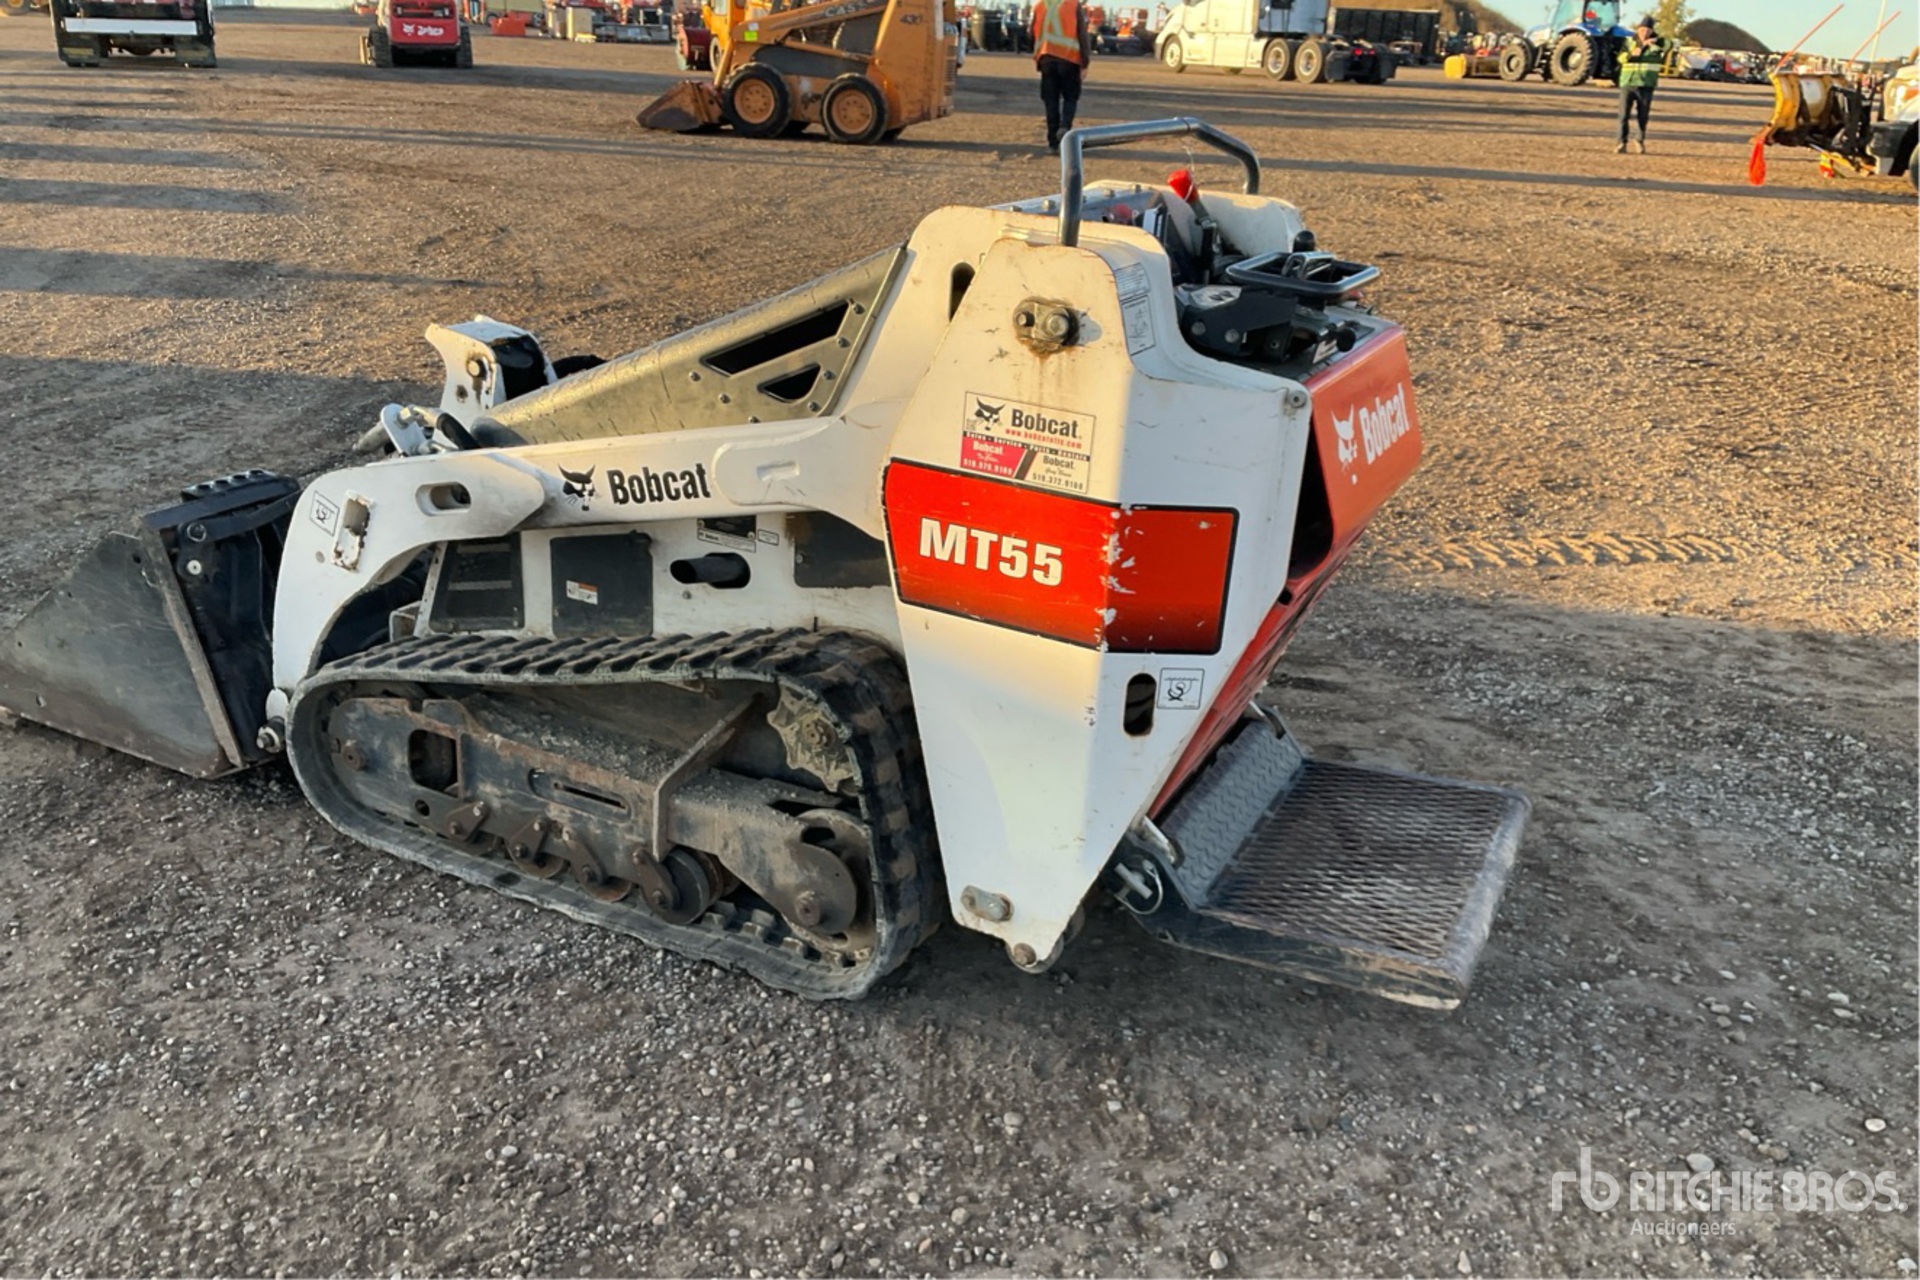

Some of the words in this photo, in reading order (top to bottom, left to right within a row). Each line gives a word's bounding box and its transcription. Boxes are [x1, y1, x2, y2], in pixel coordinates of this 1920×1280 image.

[1011, 408, 1078, 438] Bobcat
[1359, 383, 1409, 464] Bobcat
[972, 440, 1002, 455] Bobcat
[1043, 455, 1074, 469] Bobcat
[608, 462, 712, 505] Bobcat
[918, 517, 1065, 588] MT55
